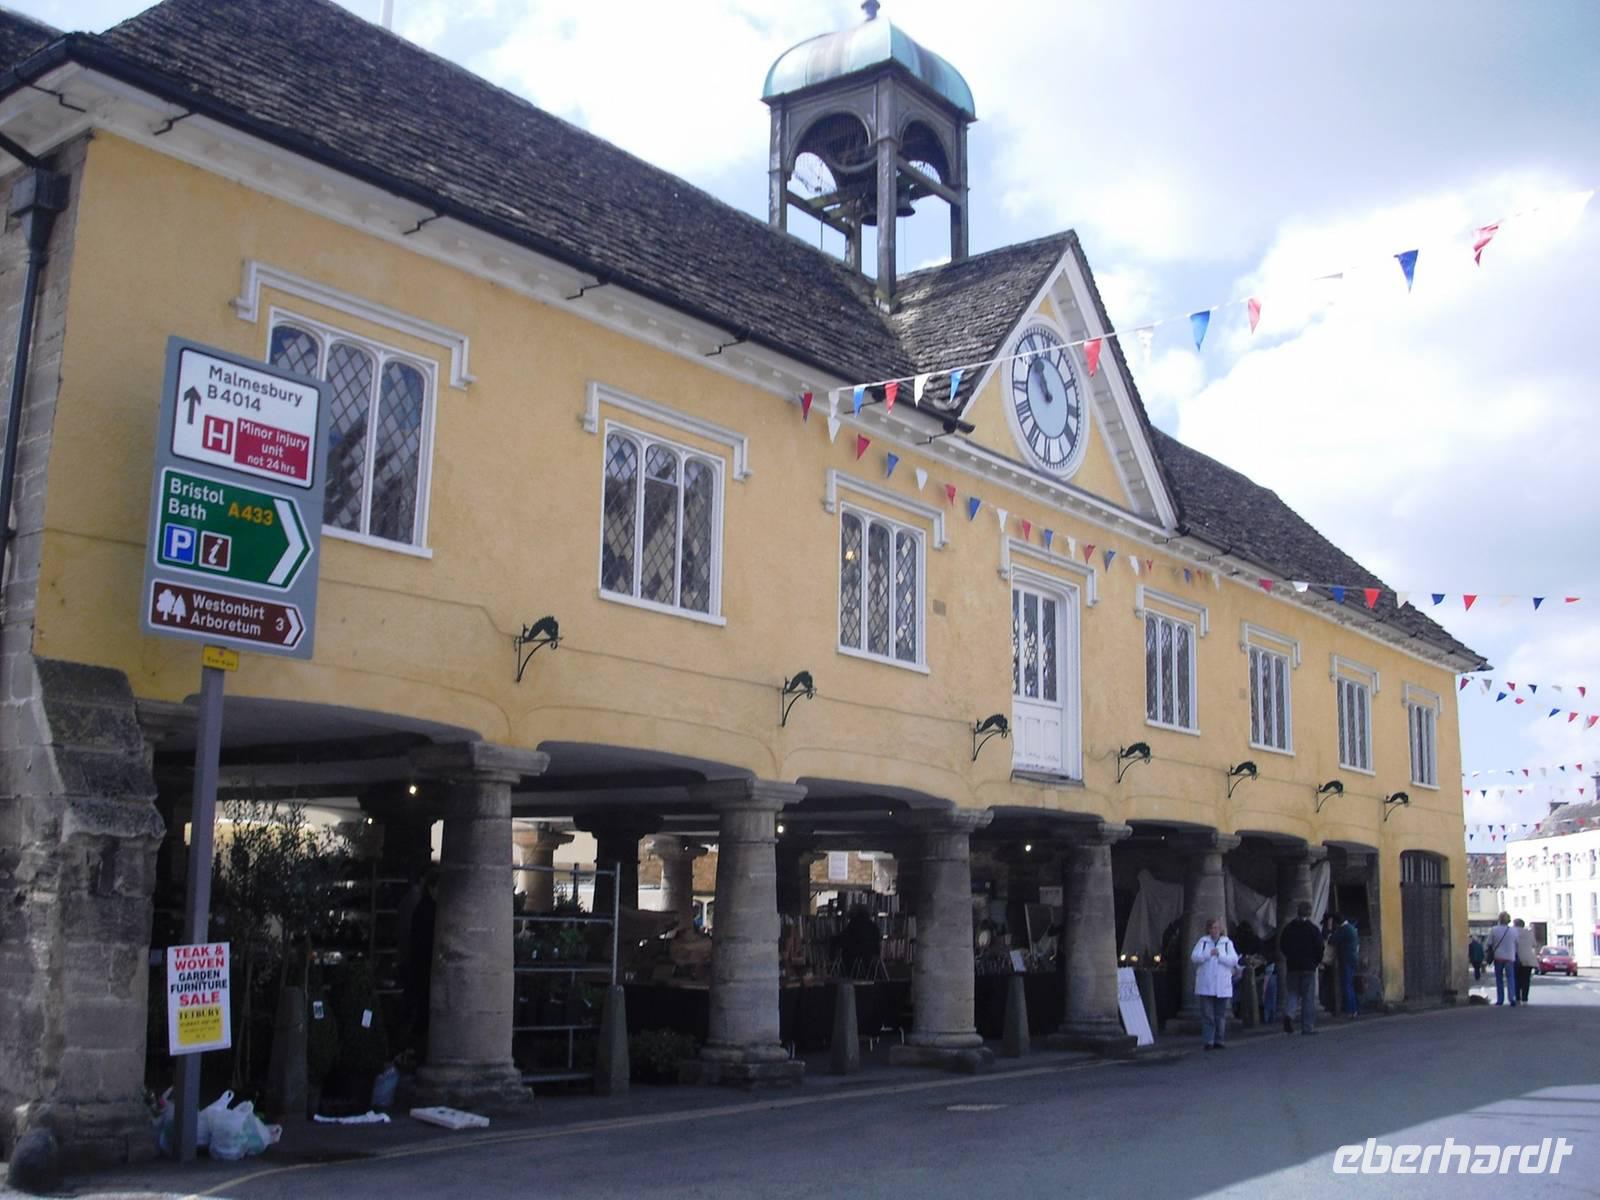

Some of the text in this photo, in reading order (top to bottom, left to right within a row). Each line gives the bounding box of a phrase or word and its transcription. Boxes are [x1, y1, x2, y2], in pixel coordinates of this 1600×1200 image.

[209, 365, 303, 407] Malmesbury
[207, 384, 262, 412] B4014
[207, 419, 229, 451] H
[240, 421, 273, 440] Minor
[261, 443, 284, 458] unit
[247, 454, 296, 475] not 24 hrs
[170, 477, 225, 506] Bristol
[168, 497, 274, 526] Bath A433
[170, 529, 192, 558] P
[193, 594, 265, 620] Westonbirt
[190, 612, 285, 636] Arboretum 3
[174, 944, 224, 958] TEAK &
[175, 957, 225, 971] WOVEN
[170, 978, 228, 994] FURNITURE
[179, 970, 220, 982] GARDEN
[179, 991, 220, 1006] SALE
